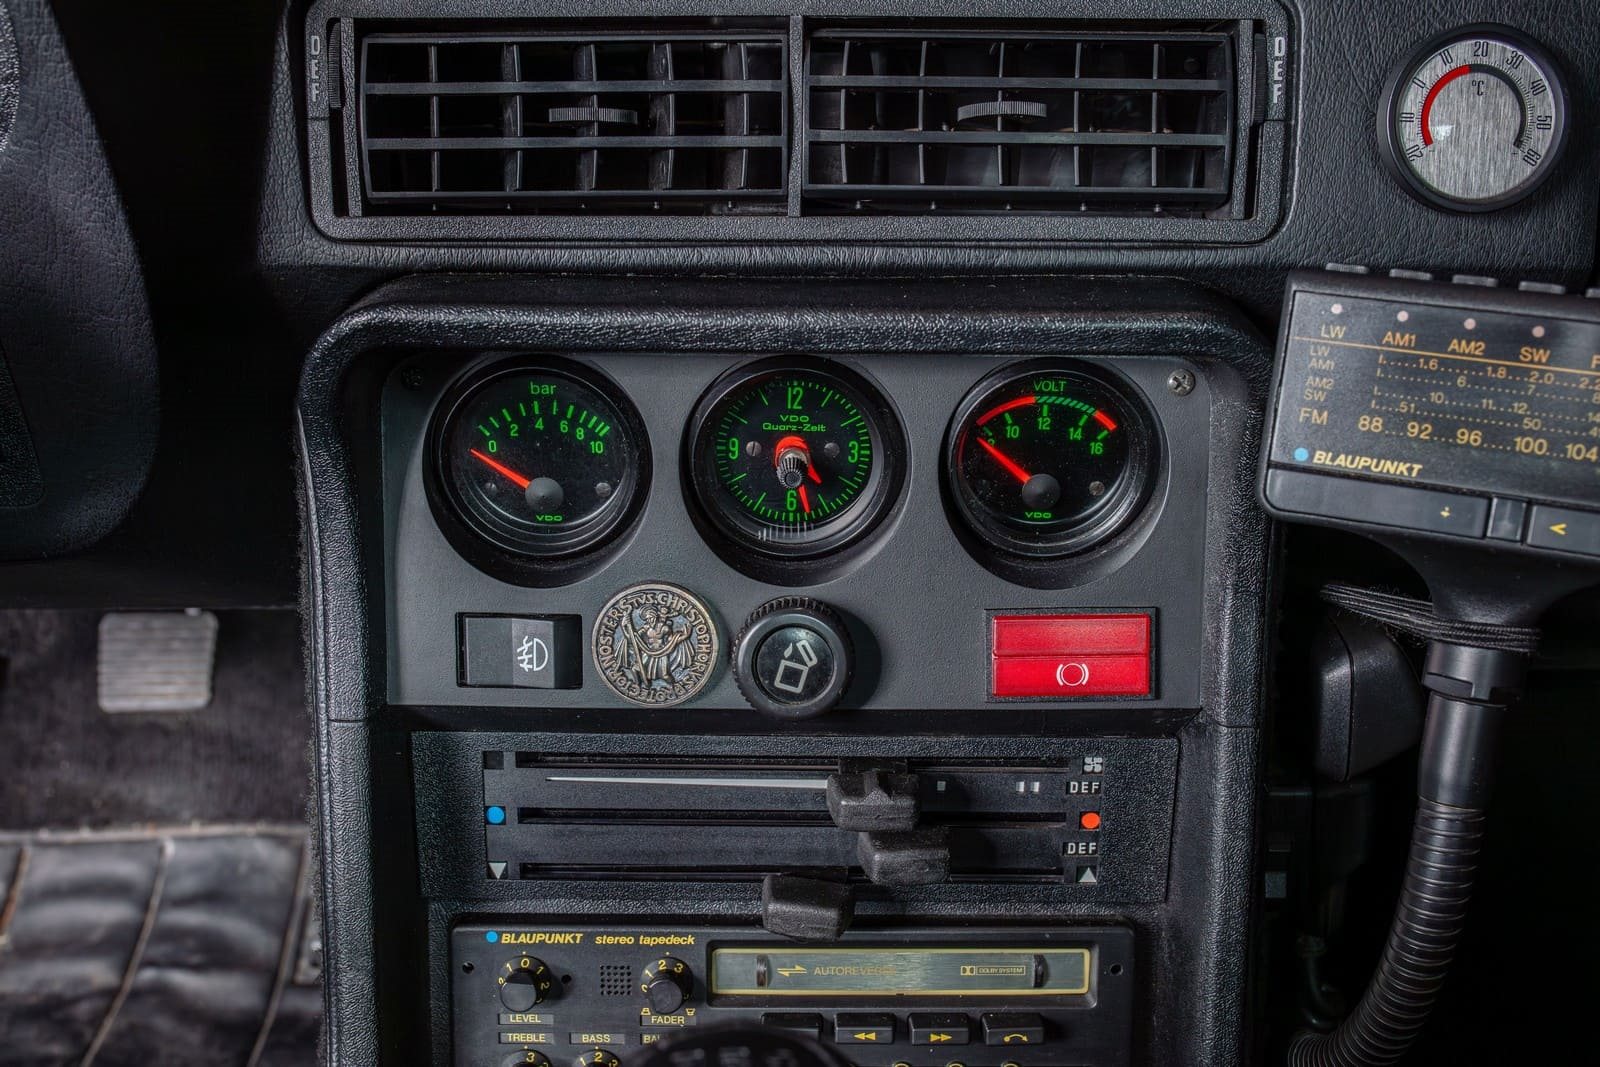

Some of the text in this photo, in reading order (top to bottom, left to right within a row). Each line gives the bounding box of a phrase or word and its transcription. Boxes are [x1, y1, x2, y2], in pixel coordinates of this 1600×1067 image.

[1473, 41, 1489, 57] 20
[1439, 49, 1453, 67] 10
[1506, 50, 1524, 70] 30
[311, 35, 320, 102] DEF
[1273, 36, 1285, 103] DEF
[1412, 76, 1426, 89] 0
[1531, 78, 1547, 96] 40
[1400, 112, 1415, 123] 10
[1537, 115, 1552, 130] 50
[1405, 144, 1423, 162] 20
[1522, 149, 1541, 167] 60
[1321, 324, 1346, 339] LW
[1382, 331, 1416, 347] AM1
[1448, 339, 1486, 356] AM2
[1519, 347, 1550, 363] SW
[1591, 354, 1600, 369] F
[1310, 346, 1330, 357] LW
[1419, 358, 1439, 371] 1.6
[1487, 366, 1507, 379] 1.8
[1529, 371, 1554, 384] 2.0
[1309, 358, 1335, 371] AM1
[1457, 375, 1466, 387] 6
[1528, 384, 1536, 395] 7
[530, 381, 557, 395] bar
[1033, 380, 1067, 392] VOLT
[787, 387, 803, 409] 12
[1305, 376, 1335, 390] AM2
[1430, 392, 1444, 404] 10
[1482, 399, 1493, 410] 11
[1512, 402, 1528, 414] 12
[1304, 389, 1327, 402] SW
[1399, 401, 1415, 413] 51
[1522, 417, 1541, 430] 50
[510, 424, 519, 437] 2
[535, 418, 544, 430] 4
[560, 420, 569, 433] 6
[762, 422, 826, 432] Quarz-Zeit
[1038, 418, 1050, 430] 12
[576, 428, 585, 440] 8
[1006, 426, 1019, 438] 10
[1069, 427, 1082, 440] 14
[1299, 408, 1598, 462] FM 88 92 96 100 104
[488, 440, 497, 452] 0
[590, 441, 604, 454] 10
[729, 438, 739, 460] 9
[848, 441, 858, 463] 3
[1090, 442, 1103, 455] 16
[1313, 450, 1423, 478] BLAUPUNKT
[786, 490, 797, 511] 6
[536, 514, 563, 522] VDO
[1070, 781, 1099, 793] DEF
[1067, 842, 1097, 854] DEF
[501, 933, 583, 944] BLAUPUNKT
[595, 934, 695, 946] stereo tapedeck
[520, 958, 530, 968] 0
[658, 959, 667, 970] 2
[674, 963, 683, 973] 3
[813, 966, 896, 976] AUTOREVE
[510, 1014, 541, 1023] LEVEL
[651, 1016, 685, 1024] FADER
[507, 1033, 546, 1042] TREBLE
[582, 1034, 611, 1043] BASS
[526, 1052, 535, 1062] 3
[595, 1051, 603, 1062] 2
